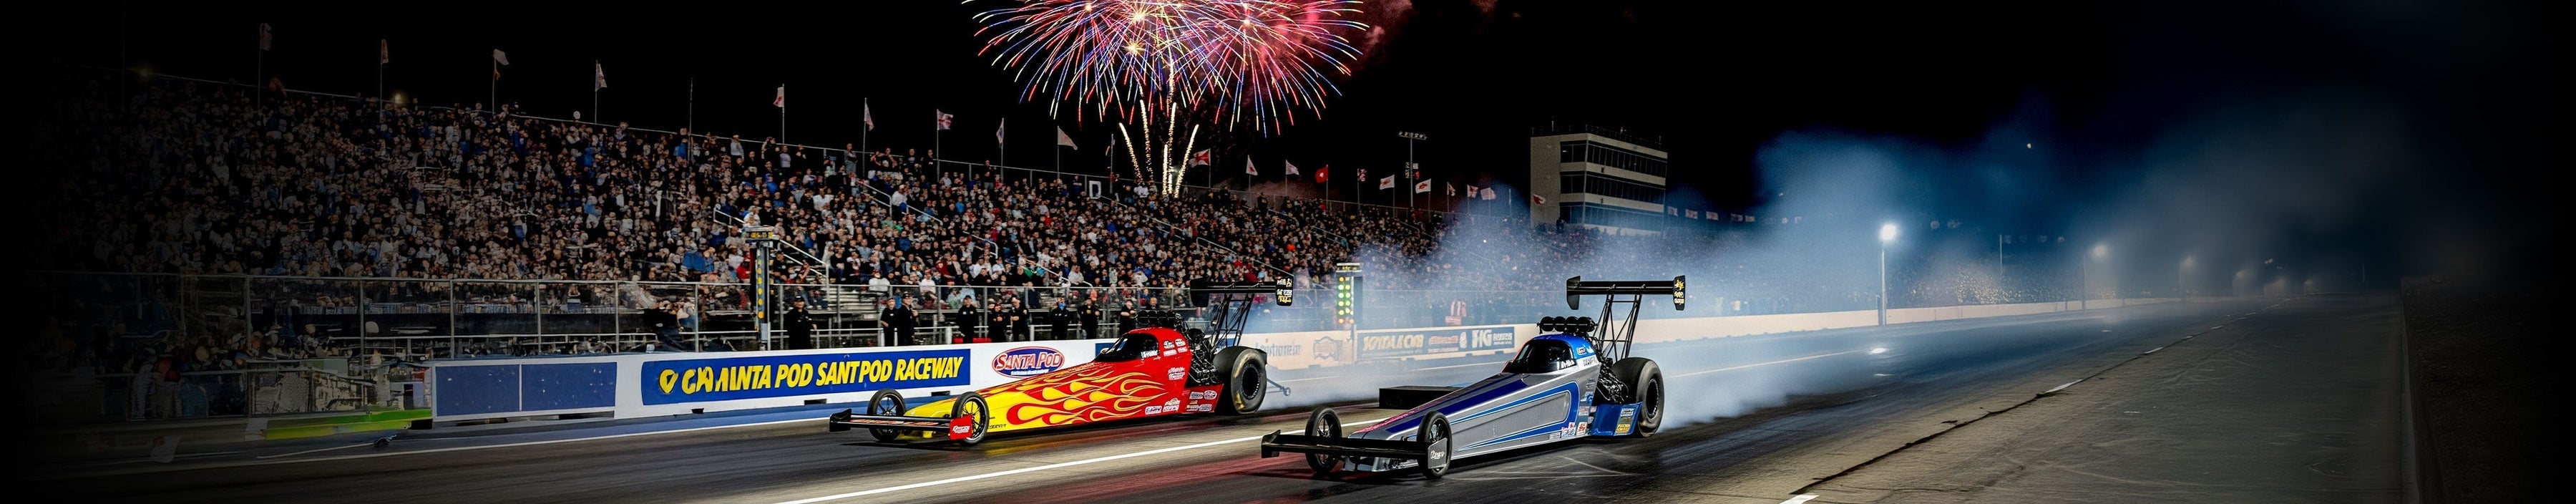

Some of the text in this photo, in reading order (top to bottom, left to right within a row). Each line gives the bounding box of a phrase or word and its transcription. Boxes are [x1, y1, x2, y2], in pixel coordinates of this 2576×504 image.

[774, 364, 814, 388] POD
[894, 357, 964, 381] RACEWAY
[994, 352, 1061, 370] SANTA POD
